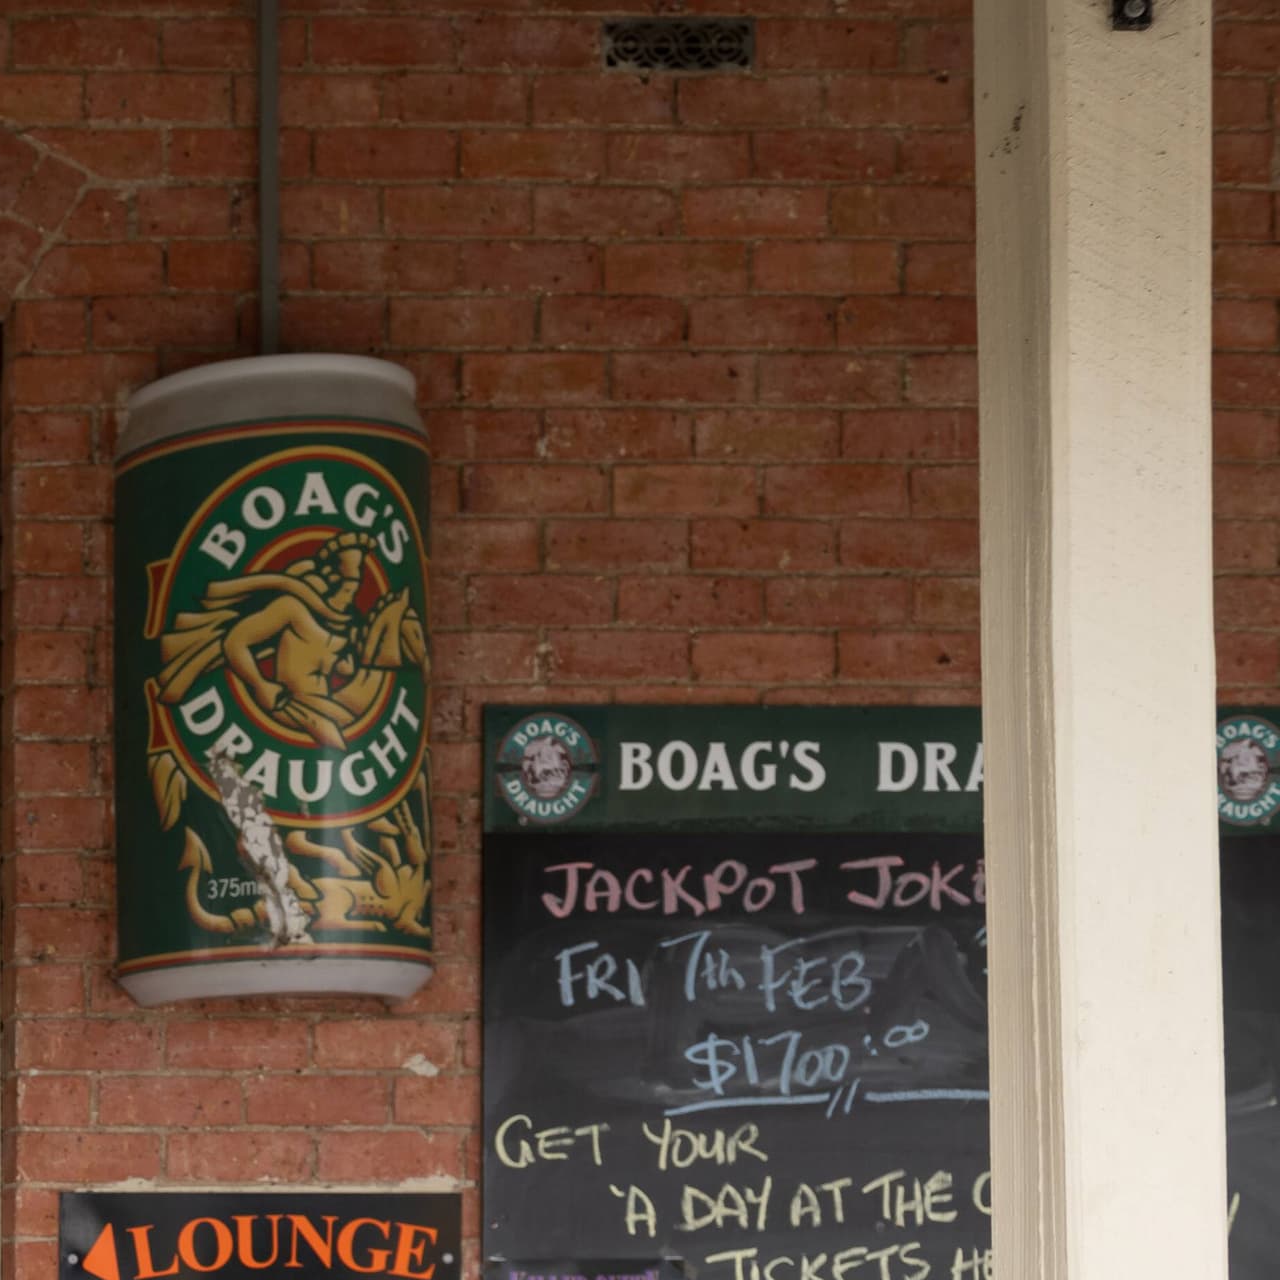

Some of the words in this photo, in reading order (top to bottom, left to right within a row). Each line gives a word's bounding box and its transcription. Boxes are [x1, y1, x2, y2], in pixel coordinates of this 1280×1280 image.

[199, 473, 409, 570] BOAG'S
[179, 687, 421, 803] DRAUGHT
[619, 741, 827, 791] BOAG'S
[506, 780, 586, 816] DRAUGHT
[207, 877, 263, 899] 375m
[542, 859, 817, 918] JACKPOT
[556, 942, 644, 1006] FRI
[759, 939, 872, 1012] FEB
[494, 1114, 609, 1168] GET
[642, 1118, 768, 1171] YOUR
[678, 1176, 772, 1231] DAY
[789, 1177, 853, 1227] AT
[862, 1170, 958, 1228] THE
[127, 1214, 438, 1280] LOUNGE
